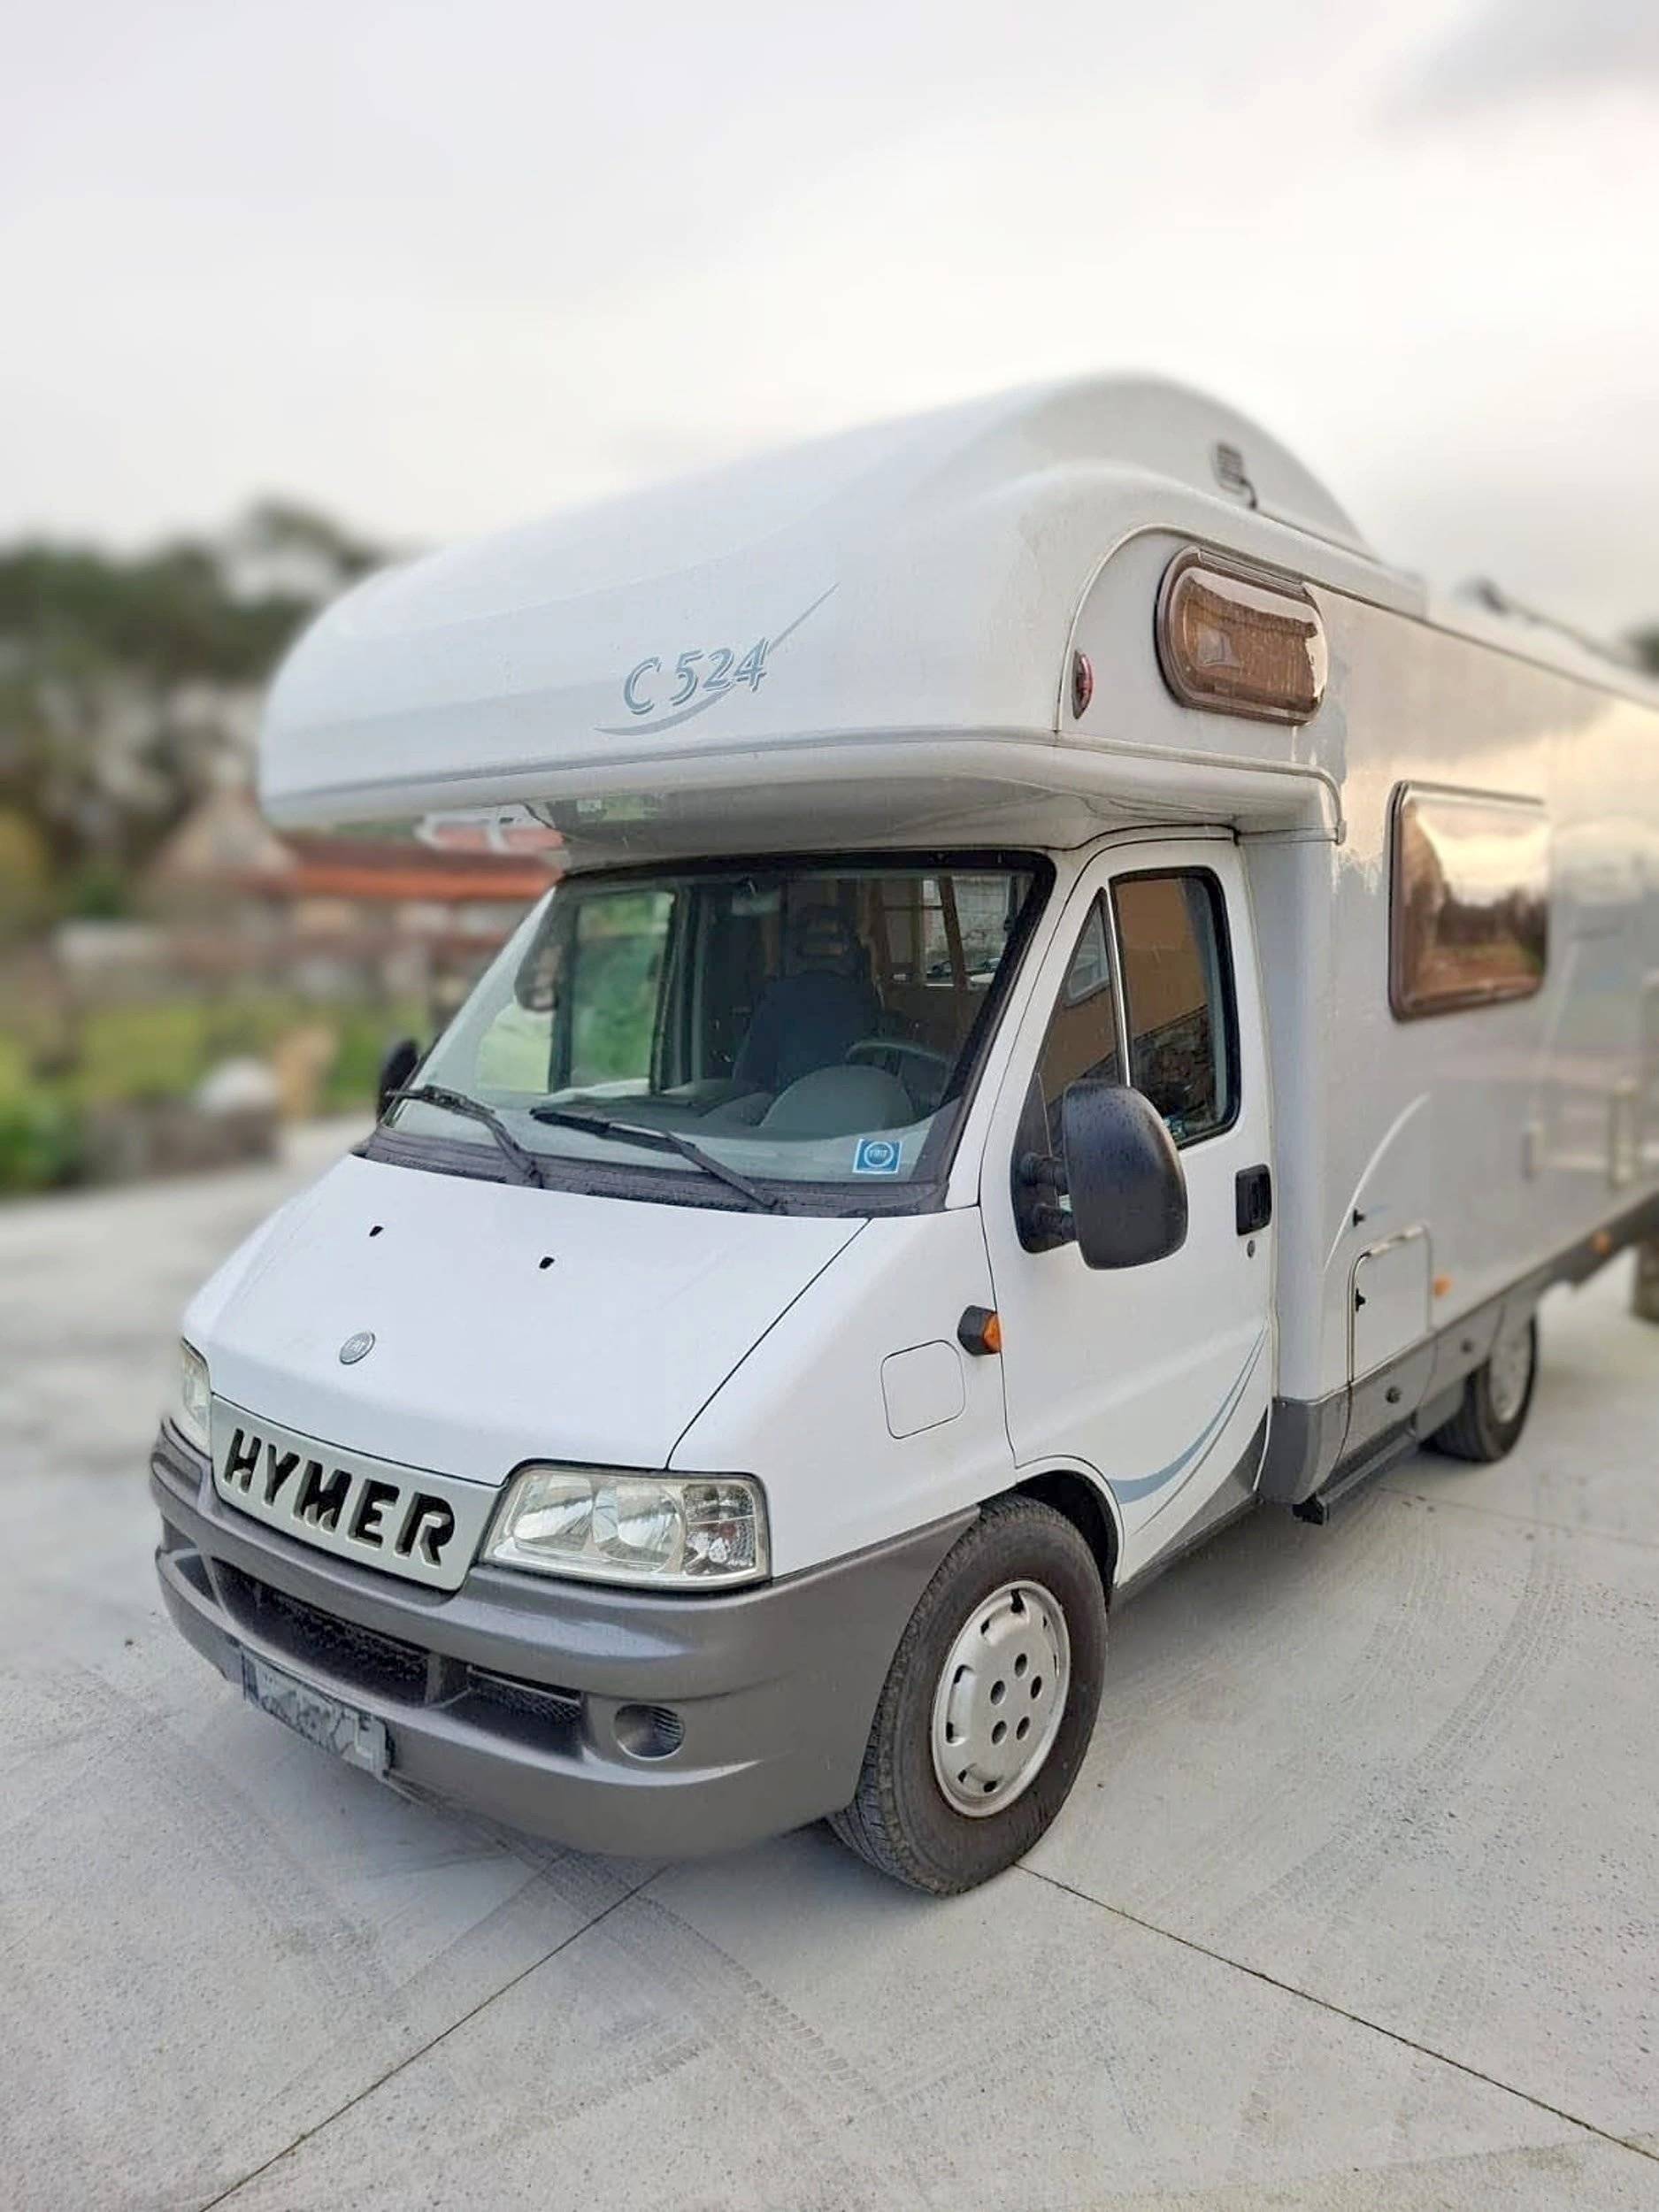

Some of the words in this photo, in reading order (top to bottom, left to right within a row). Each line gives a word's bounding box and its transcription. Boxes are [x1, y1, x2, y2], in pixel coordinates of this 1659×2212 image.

[624, 657, 662, 715] C
[670, 636, 771, 706] 524
[223, 1427, 456, 1567] HYMER
